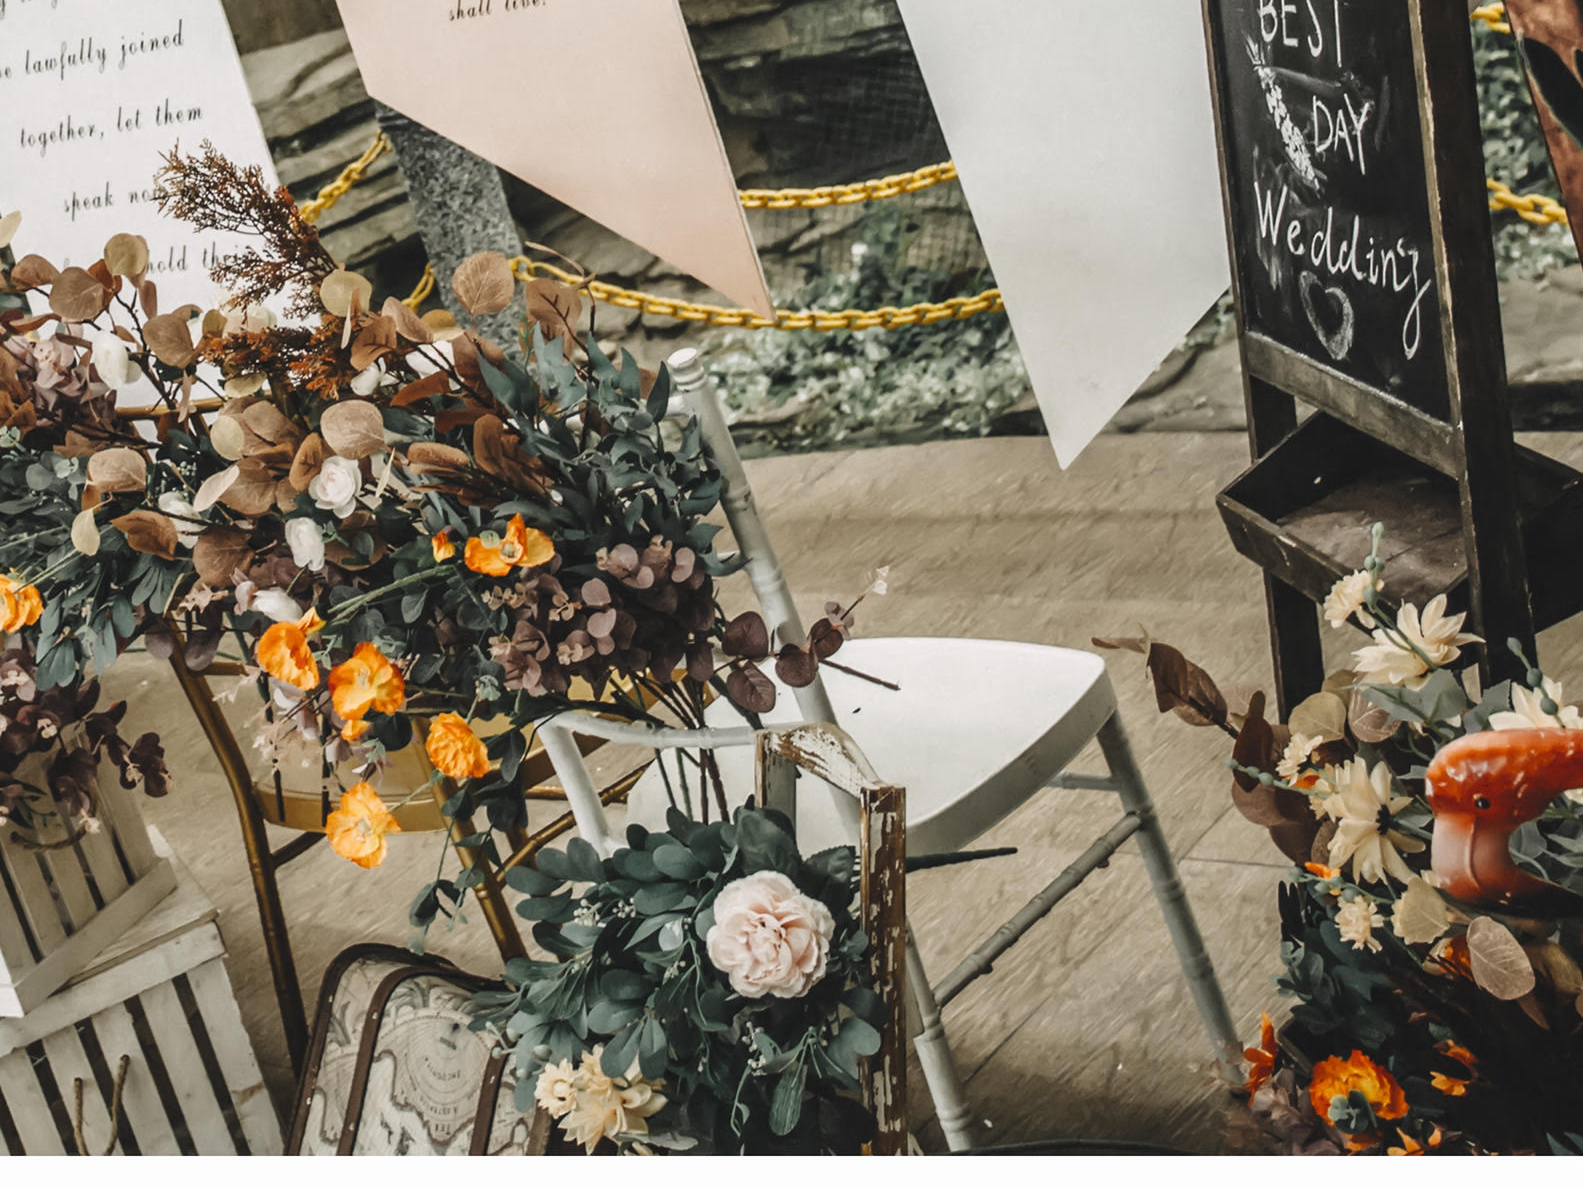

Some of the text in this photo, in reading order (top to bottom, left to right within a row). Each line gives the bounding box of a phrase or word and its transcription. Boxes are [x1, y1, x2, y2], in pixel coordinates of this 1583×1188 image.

[24, 36, 107, 82] lawfully
[118, 18, 184, 70] joined
[116, 105, 141, 133] let
[155, 97, 202, 127] them
[1312, 93, 1370, 175] DAY
[64, 181, 113, 223] speak
[1253, 180, 1432, 361] Wedding
